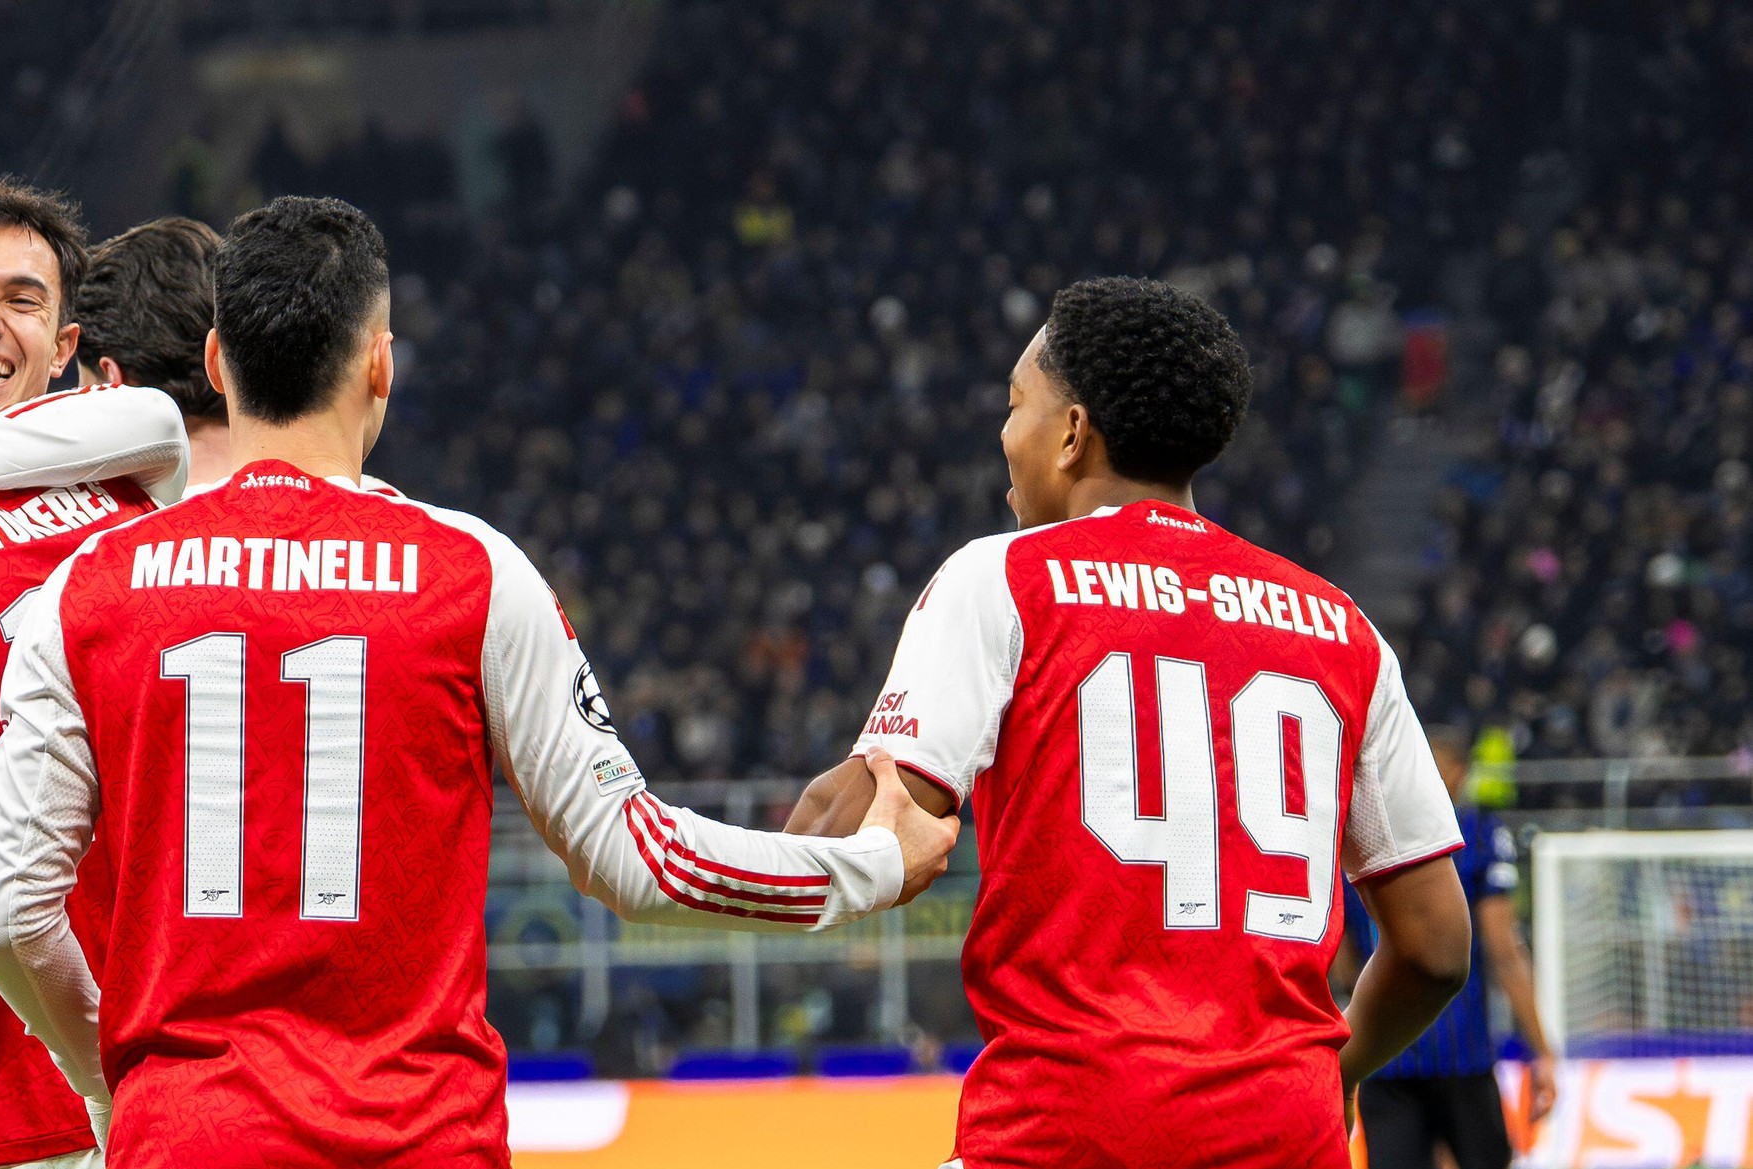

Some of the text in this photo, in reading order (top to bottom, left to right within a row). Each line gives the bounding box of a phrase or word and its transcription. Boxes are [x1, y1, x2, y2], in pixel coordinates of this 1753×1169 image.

[240, 472, 311, 491] Arsenal
[1146, 509, 1208, 533] Arsenal
[130, 536, 418, 593] MARTINELLI
[1046, 559, 1350, 645] LEWIS-SKELLY
[159, 631, 368, 922] 11
[1078, 652, 1344, 945] 49
